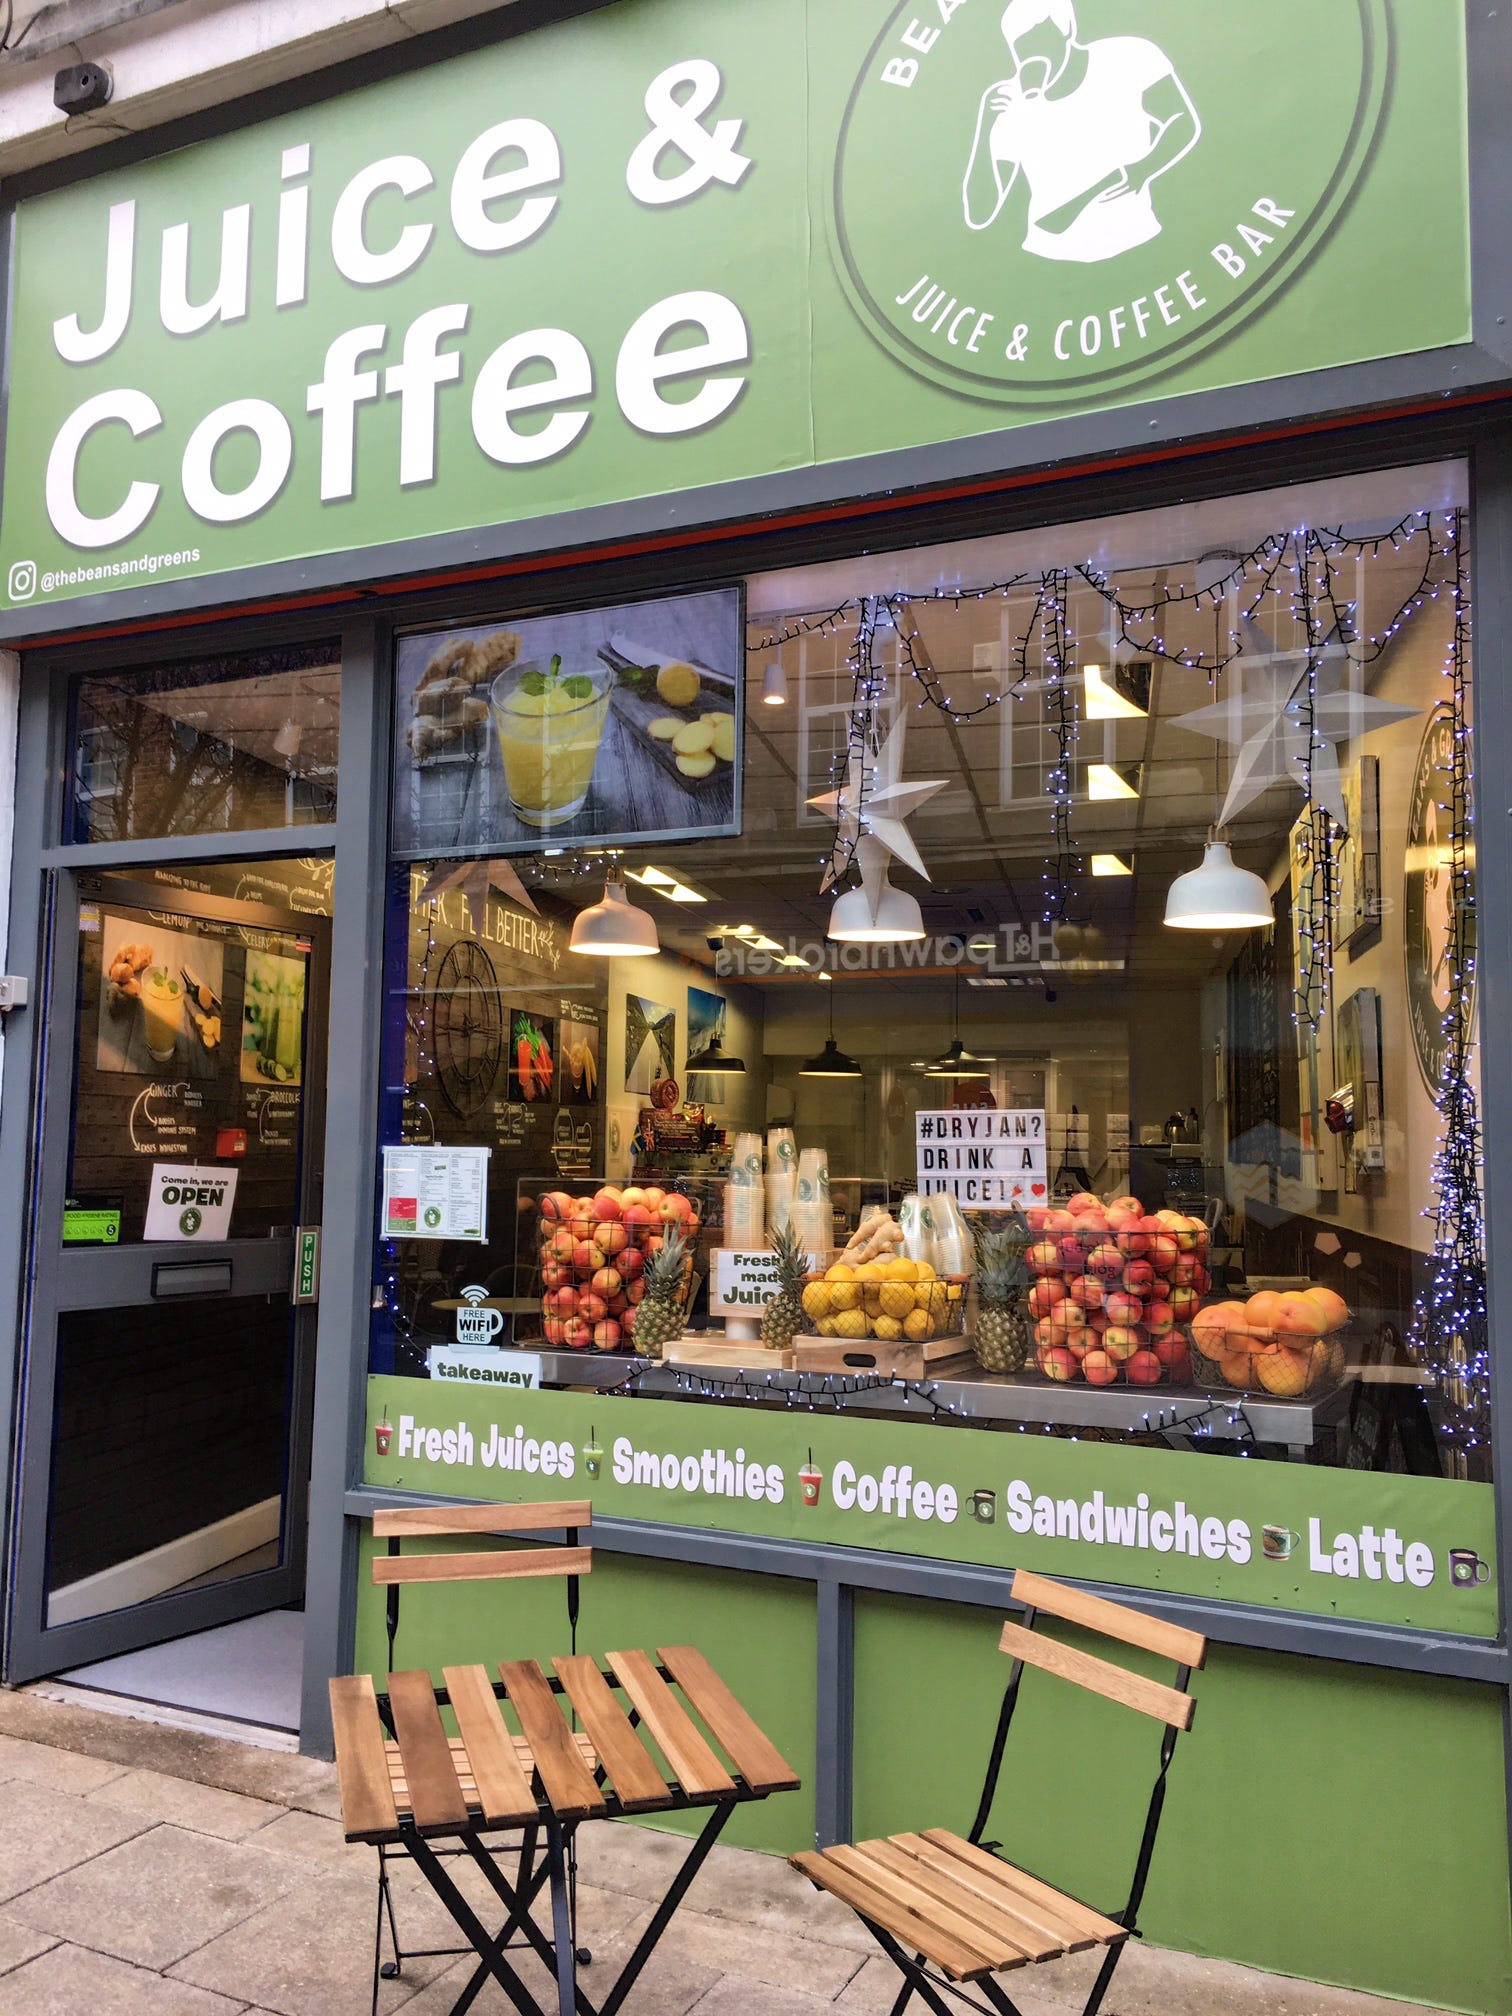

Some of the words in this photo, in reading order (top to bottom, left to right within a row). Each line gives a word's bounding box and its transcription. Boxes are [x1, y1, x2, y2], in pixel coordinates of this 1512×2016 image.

[53, 118, 562, 363] Juice
[626, 59, 752, 205] &
[896, 274, 996, 355] JUICE
[1005, 324, 1030, 362] &
[1053, 270, 1207, 361] COFFEE
[1210, 197, 1296, 279] BAR
[45, 290, 749, 548] Coffee
[41, 548, 201, 592] @thebeansandgreens
[162, 912, 191, 928] LEMON
[150, 1083, 178, 1097] GINGER
[924, 1148, 994, 1169] DRINK
[1021, 1147, 1033, 1169] A
[161, 1176, 188, 1184] Come
[162, 1186, 225, 1207] OPEN
[302, 1235, 313, 1291] PUSH
[741, 1271, 781, 1283] mad
[463, 1309, 485, 1319] FREE
[459, 1319, 490, 1332] WIFI
[462, 1333, 485, 1342] HERE
[437, 1362, 533, 1389] takeaway
[398, 1414, 474, 1466] Fresh
[480, 1423, 576, 1479] Juices
[613, 1436, 785, 1504] Smoothies
[832, 1460, 959, 1524] Coffee
[1006, 1479, 1252, 1565] Sandwiches
[1308, 1517, 1435, 1588] Latte
